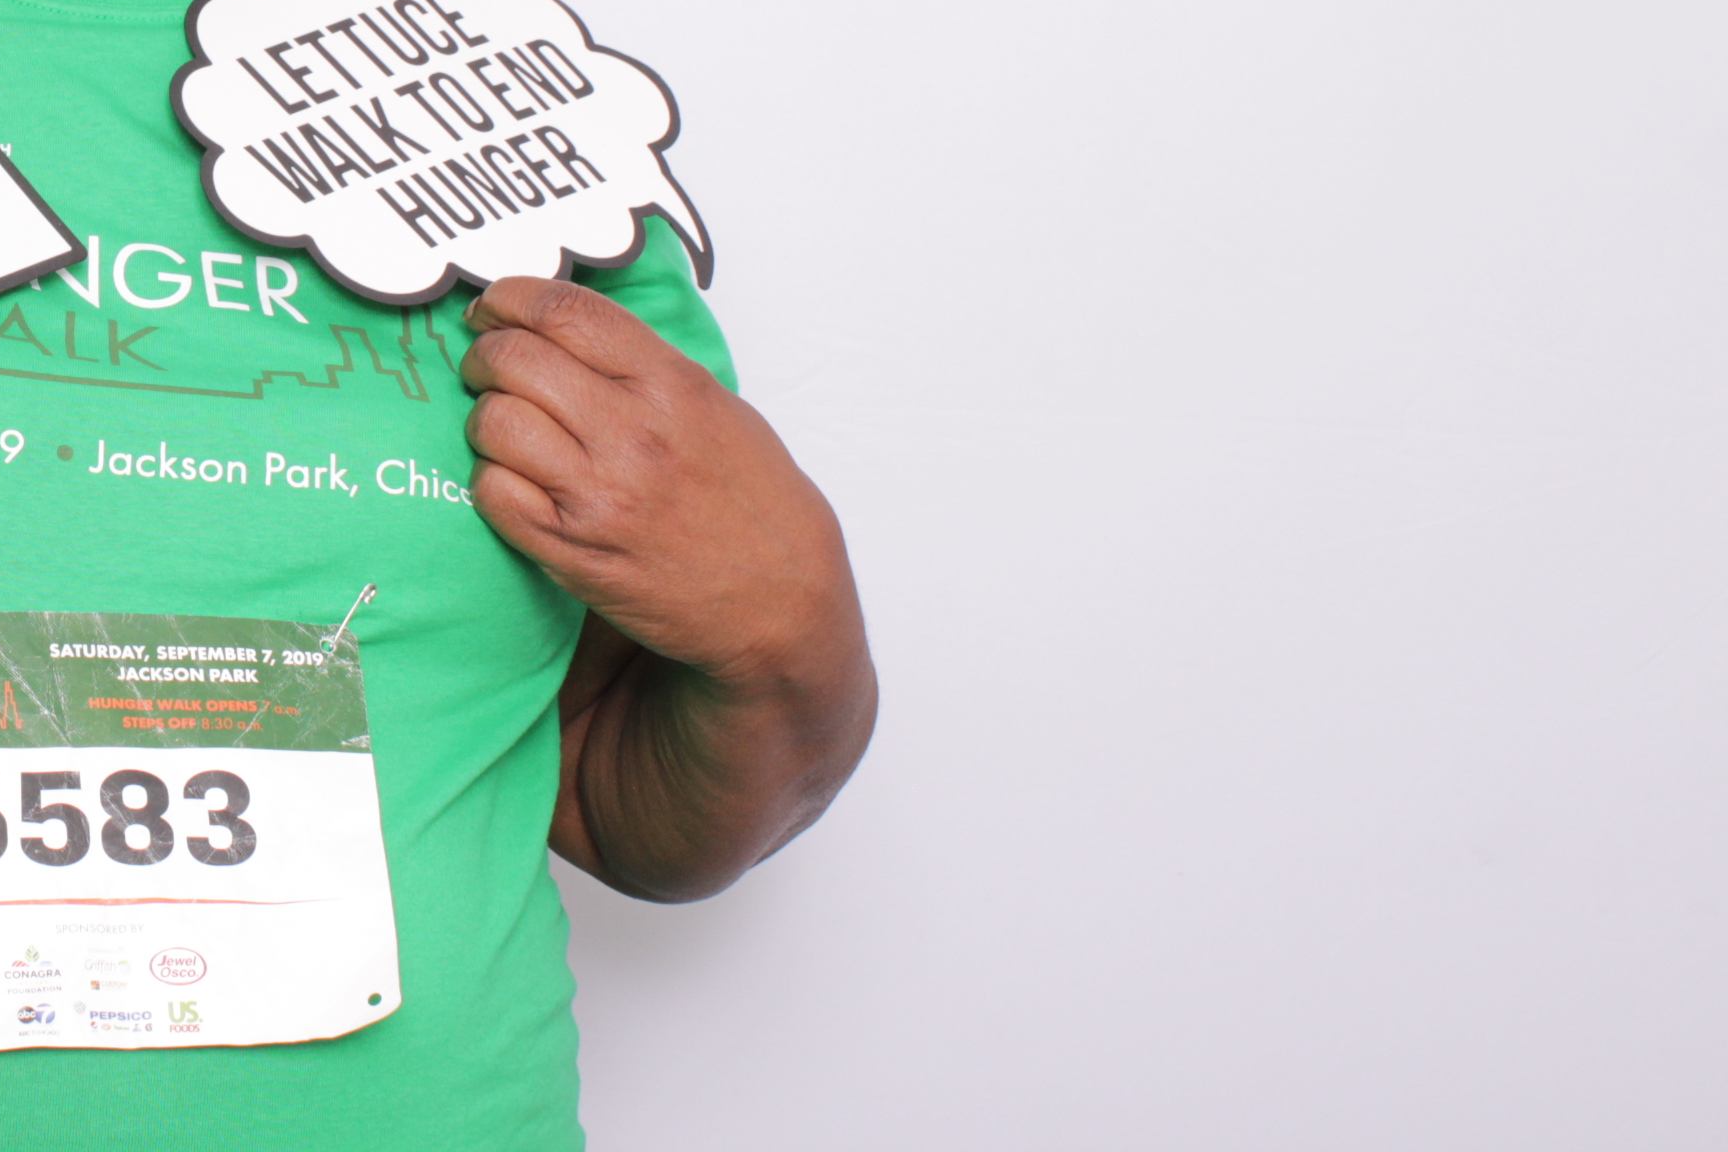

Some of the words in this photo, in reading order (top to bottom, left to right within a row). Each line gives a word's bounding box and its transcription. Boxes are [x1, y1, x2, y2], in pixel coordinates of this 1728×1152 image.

[243, 96, 432, 204] WALK
[393, 71, 495, 142] TO
[465, 38, 595, 121] END
[374, 124, 607, 248] HUNGER
[30, 234, 310, 324] NGER
[88, 439, 248, 485] Jackson
[264, 451, 360, 498] Park,
[48, 643, 150, 662] SATURDAY,
[156, 645, 258, 663] SEPTEMBER
[261, 649, 276, 666] 7,
[282, 650, 324, 667] 2019
[117, 666, 205, 682] JACKSON
[209, 668, 259, 683] PARK
[88, 697, 154, 711] HUNGER
[156, 699, 203, 712] WALK
[205, 700, 258, 713] OPENS
[122, 717, 165, 729] STEPS
[168, 717, 197, 730] OFF
[201, 717, 234, 730] 8:30
[55, 923, 127, 935] SPONSORED
[157, 954, 197, 967] Jewel
[4, 968, 62, 980] CONAGRA
[160, 967, 197, 979] Osco
[7, 985, 62, 995] FOUNDATION
[17, 1010, 37, 1019] abc
[89, 1010, 152, 1021] PEPSICO
[169, 1024, 201, 1033] FOODS
